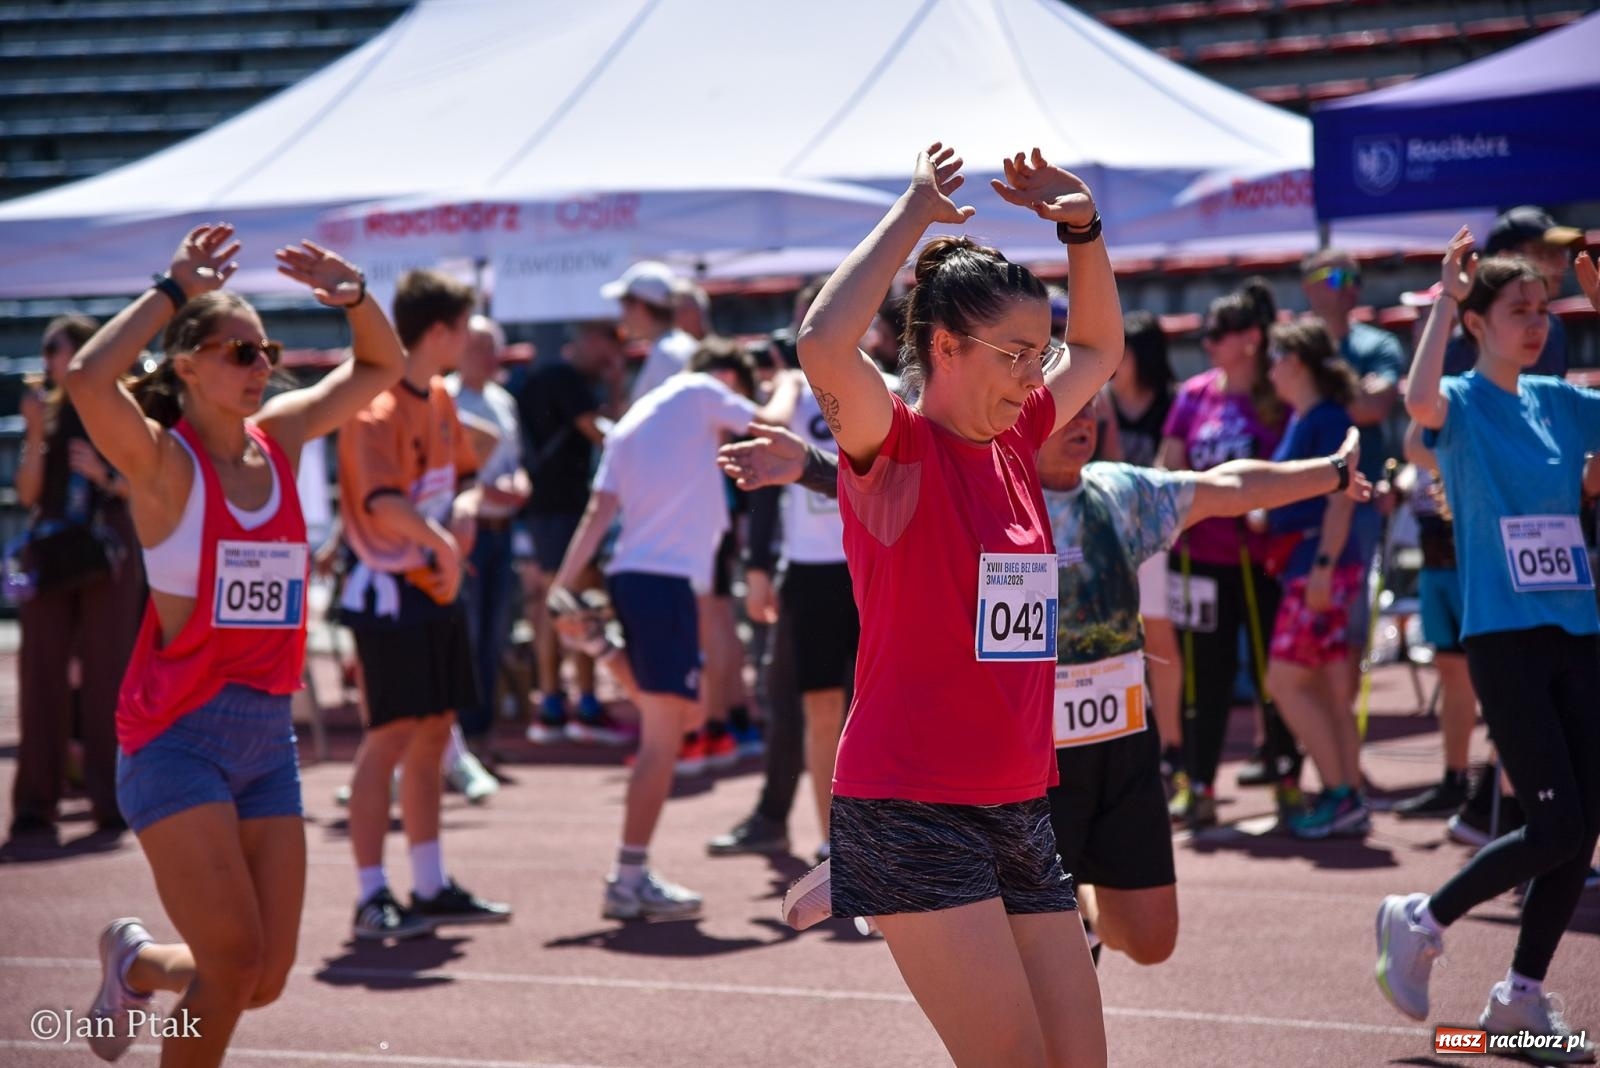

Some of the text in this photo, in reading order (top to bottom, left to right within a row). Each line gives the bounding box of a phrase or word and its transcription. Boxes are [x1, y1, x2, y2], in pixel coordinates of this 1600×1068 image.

[986, 562, 1003, 573] XVIII
[1004, 562, 1020, 573] BIEG
[1020, 562, 1031, 573] BEZ
[1519, 546, 1571, 576] 056
[986, 574, 1024, 585] 3MAJA2026
[227, 580, 283, 613] 058
[991, 601, 1044, 641] 042
[1064, 694, 1118, 731] 100
